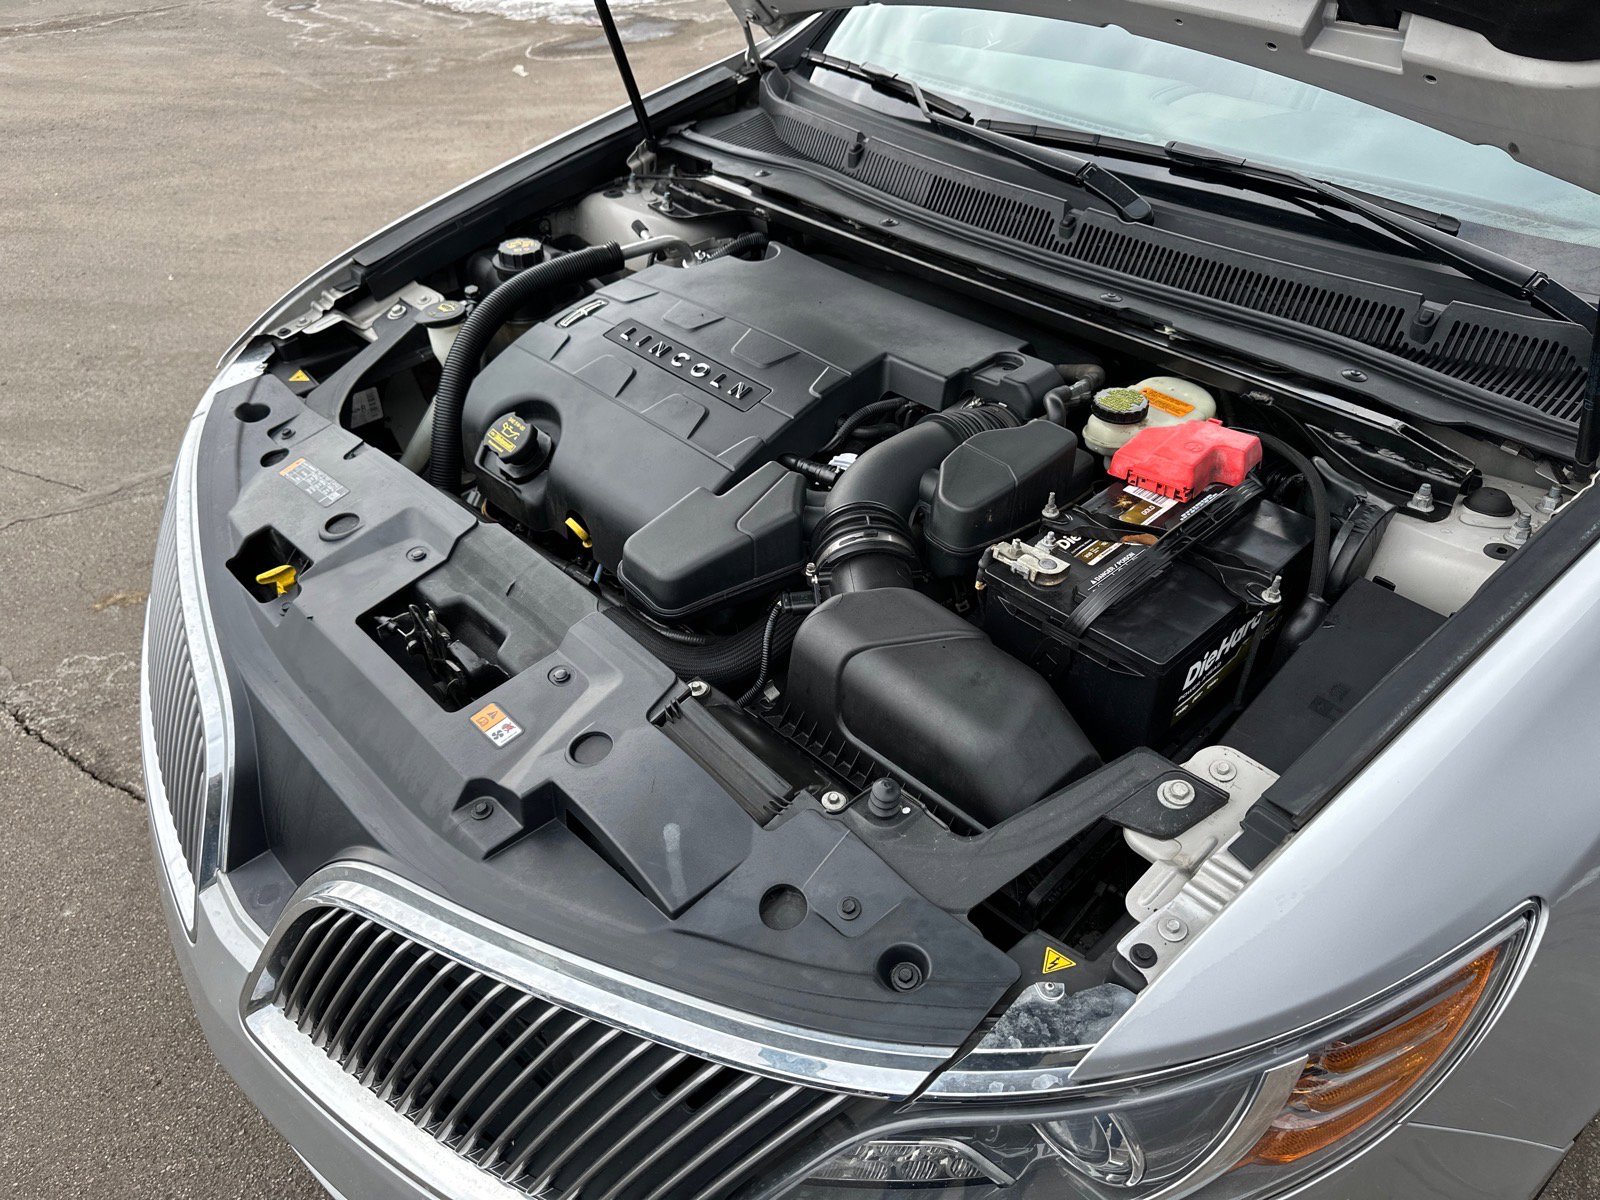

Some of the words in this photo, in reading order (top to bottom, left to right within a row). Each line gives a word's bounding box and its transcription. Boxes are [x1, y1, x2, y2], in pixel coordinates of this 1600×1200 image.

[620, 327, 753, 399] LINCOLN
[1094, 566, 1115, 581] DANGER
[1117, 552, 1136, 568] POISON
